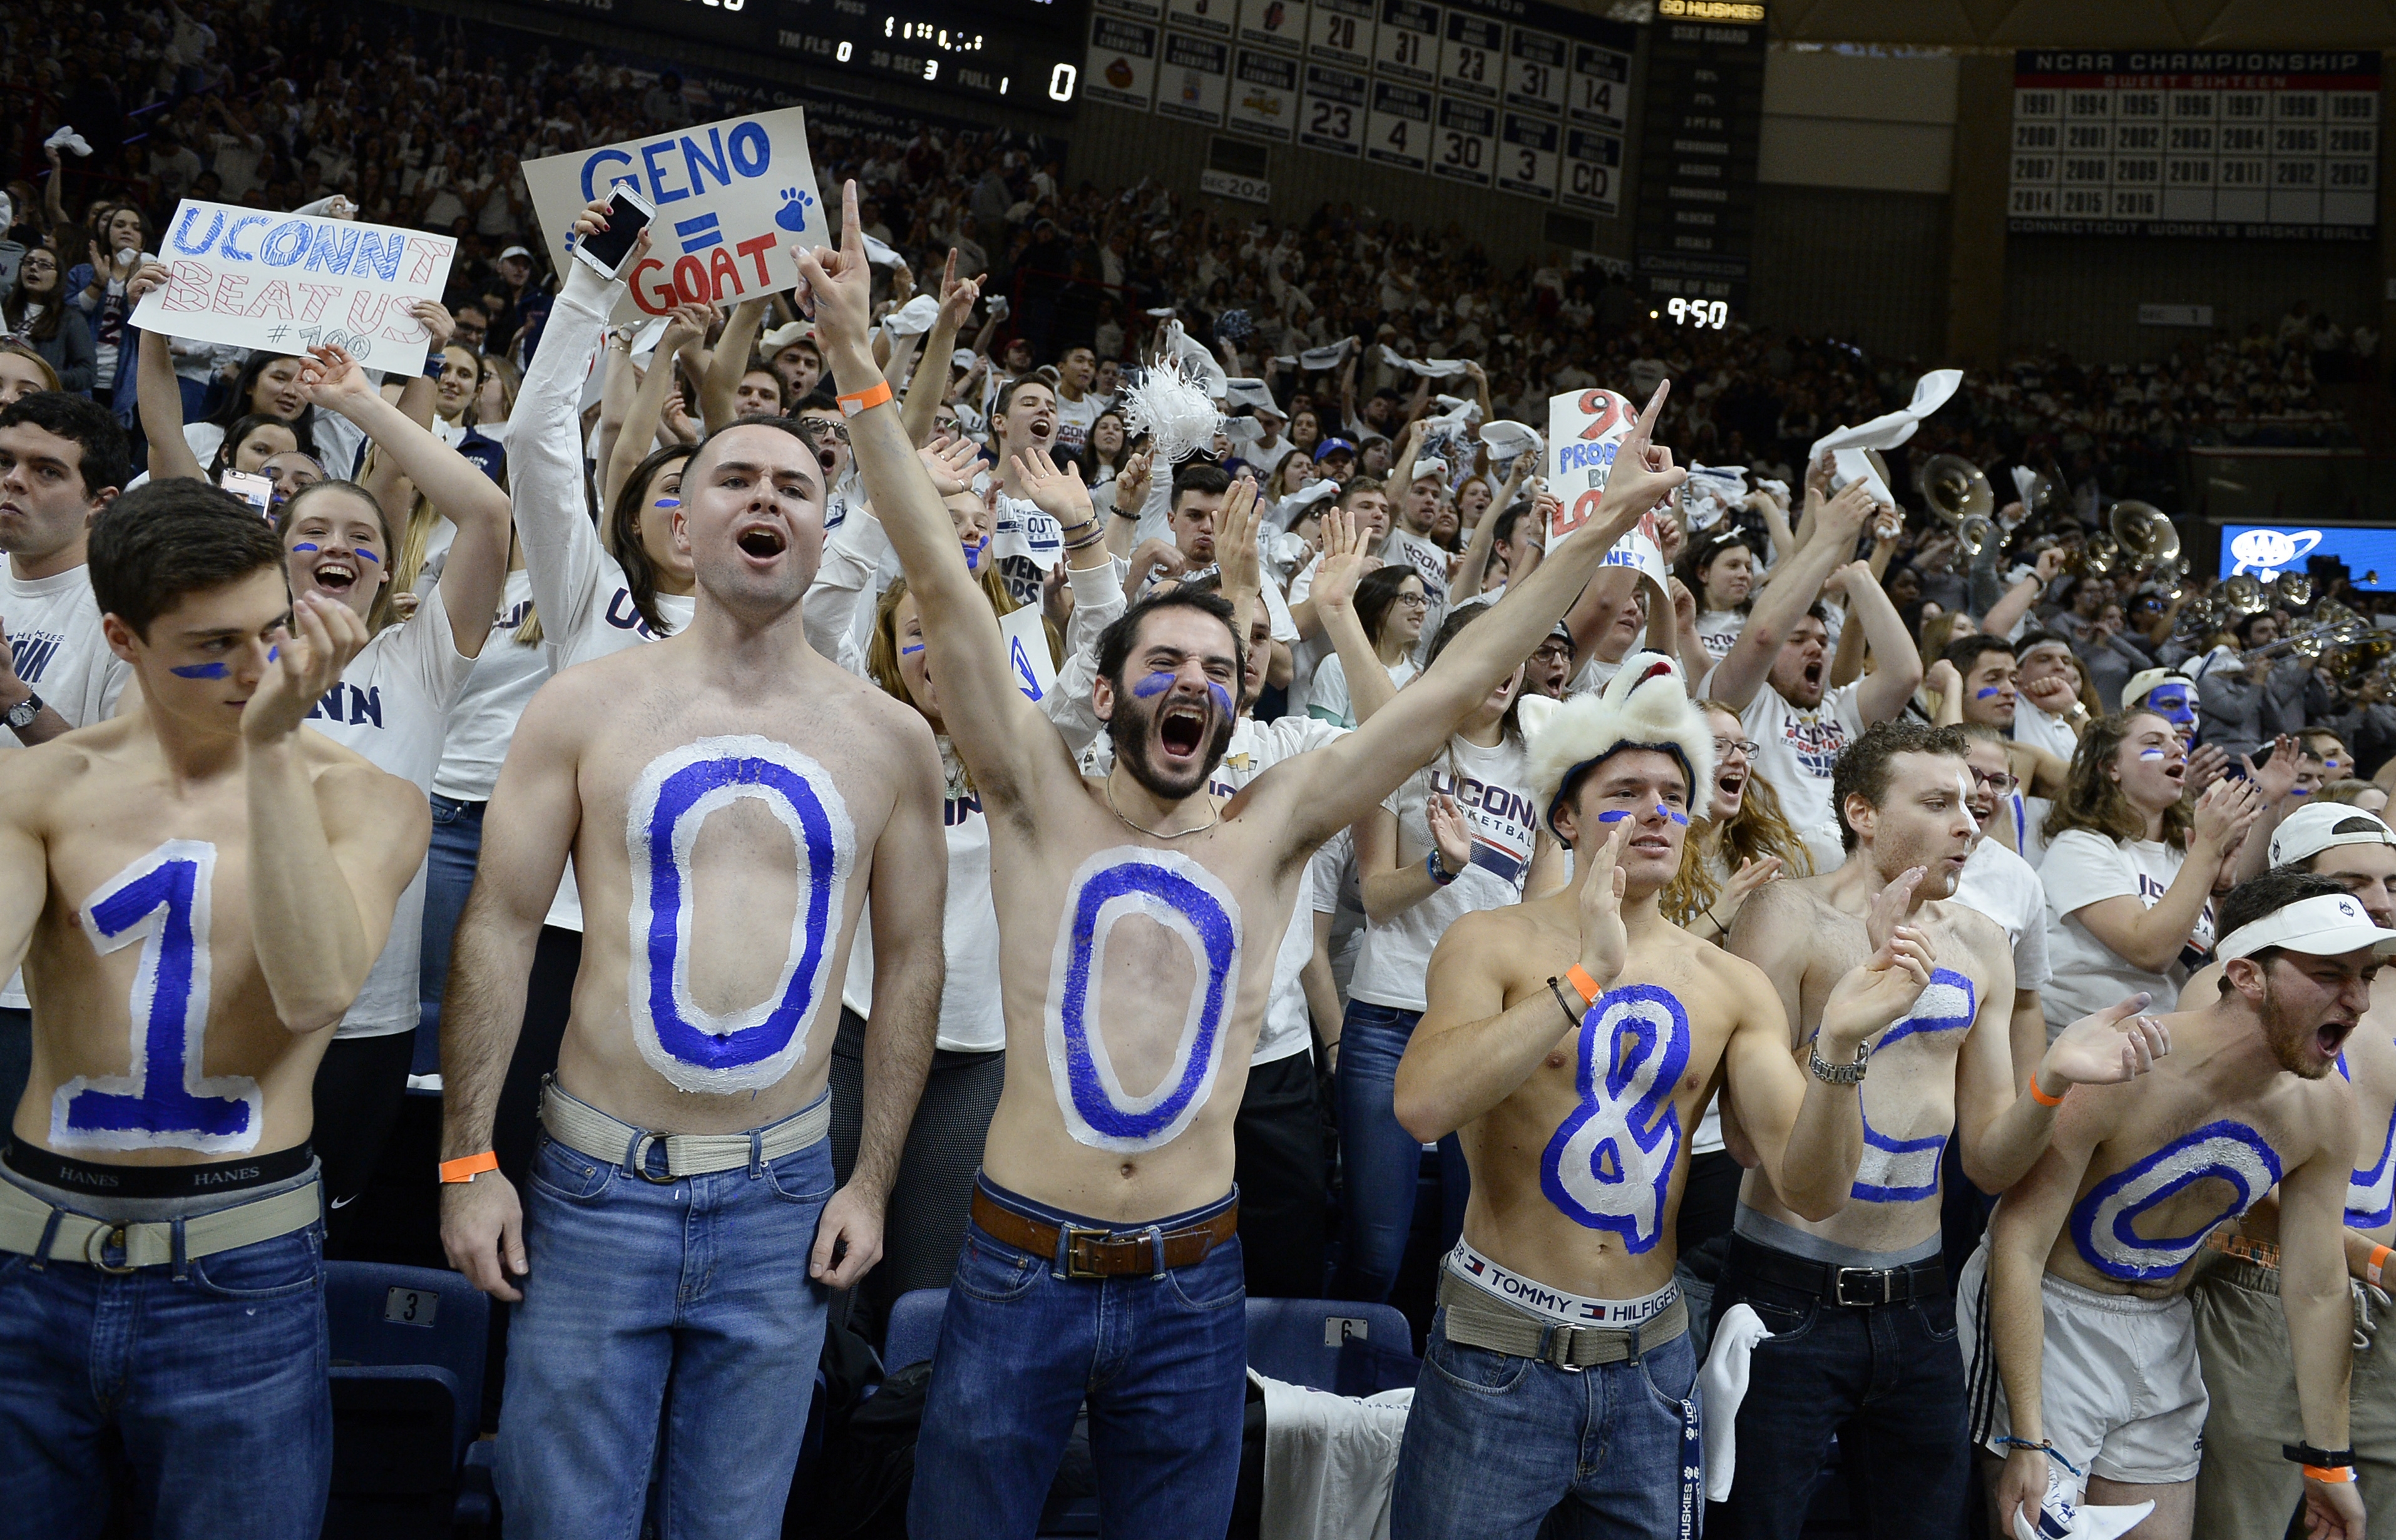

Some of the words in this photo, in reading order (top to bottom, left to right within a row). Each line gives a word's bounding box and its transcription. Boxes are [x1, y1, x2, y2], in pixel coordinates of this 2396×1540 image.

[1659, 0, 1686, 14] GO
[1686, 1, 1765, 21] HUSKIES
[1329, 16, 1354, 49] 20
[1396, 32, 1420, 65] 31
[836, 41, 852, 63] 0
[1459, 47, 1485, 81] 23
[2036, 54, 2114, 70] NCAA
[2130, 54, 2358, 71] CHAMPIONSHIP
[923, 59, 938, 81] 3
[958, 68, 991, 90] FULL
[1048, 63, 1077, 102] 0
[1522, 65, 1549, 98] 31
[2102, 74, 2178, 88] SWEET
[2191, 75, 2287, 88] SIXTEEN
[1585, 80, 1611, 113] 14
[2023, 94, 2056, 113] 1991
[2072, 94, 2107, 114] 1994
[2123, 94, 2159, 115] 1995
[2176, 95, 2211, 116] 1996
[2228, 95, 2264, 116] 1997
[2335, 96, 2372, 118] 1999
[1312, 103, 1351, 140] 23
[1388, 121, 1406, 153] 4
[1445, 133, 1481, 168] 30
[2018, 127, 2056, 146] 2000
[2071, 127, 2106, 147] 2001
[2119, 127, 2158, 148] 2002
[2171, 128, 2211, 148] 2003
[2224, 128, 2265, 149] 2004
[581, 121, 771, 205] GENO
[1518, 150, 1536, 181] 3
[2015, 158, 2054, 178] 2007
[2171, 160, 2210, 181] 2010
[2224, 163, 2263, 183] 2011
[2278, 163, 2315, 183] 2012
[1230, 178, 1266, 199] 204
[1573, 163, 1607, 198] CD
[2014, 193, 2052, 213] 2014
[2066, 193, 2102, 213] 2015
[2116, 194, 2154, 213] 2016
[2009, 220, 2141, 236] CONNECTICUT
[2148, 222, 2238, 237] WOMEN'S
[2246, 223, 2373, 241] BASKETBALL
[628, 232, 777, 315] GOAT
[161, 260, 342, 323] BEAT
[347, 290, 431, 344] US
[1667, 297, 1728, 330] 9:50
[1560, 442, 1619, 474] PROB
[1028, 517, 1053, 533] OUT
[1430, 770, 1537, 832] UCON
[56, 848, 257, 1145] 1
[1540, 982, 1690, 1255] &
[61, 1166, 119, 1187] HANES
[195, 1166, 260, 1186] HANES
[1490, 1268, 1572, 1313] TOMMY
[1613, 1285, 1677, 1322] HILFIGER
[403, 1293, 418, 1321] 3
[1341, 1319, 1353, 1344] 6
[1681, 1483, 1692, 1540] HUSKIES
